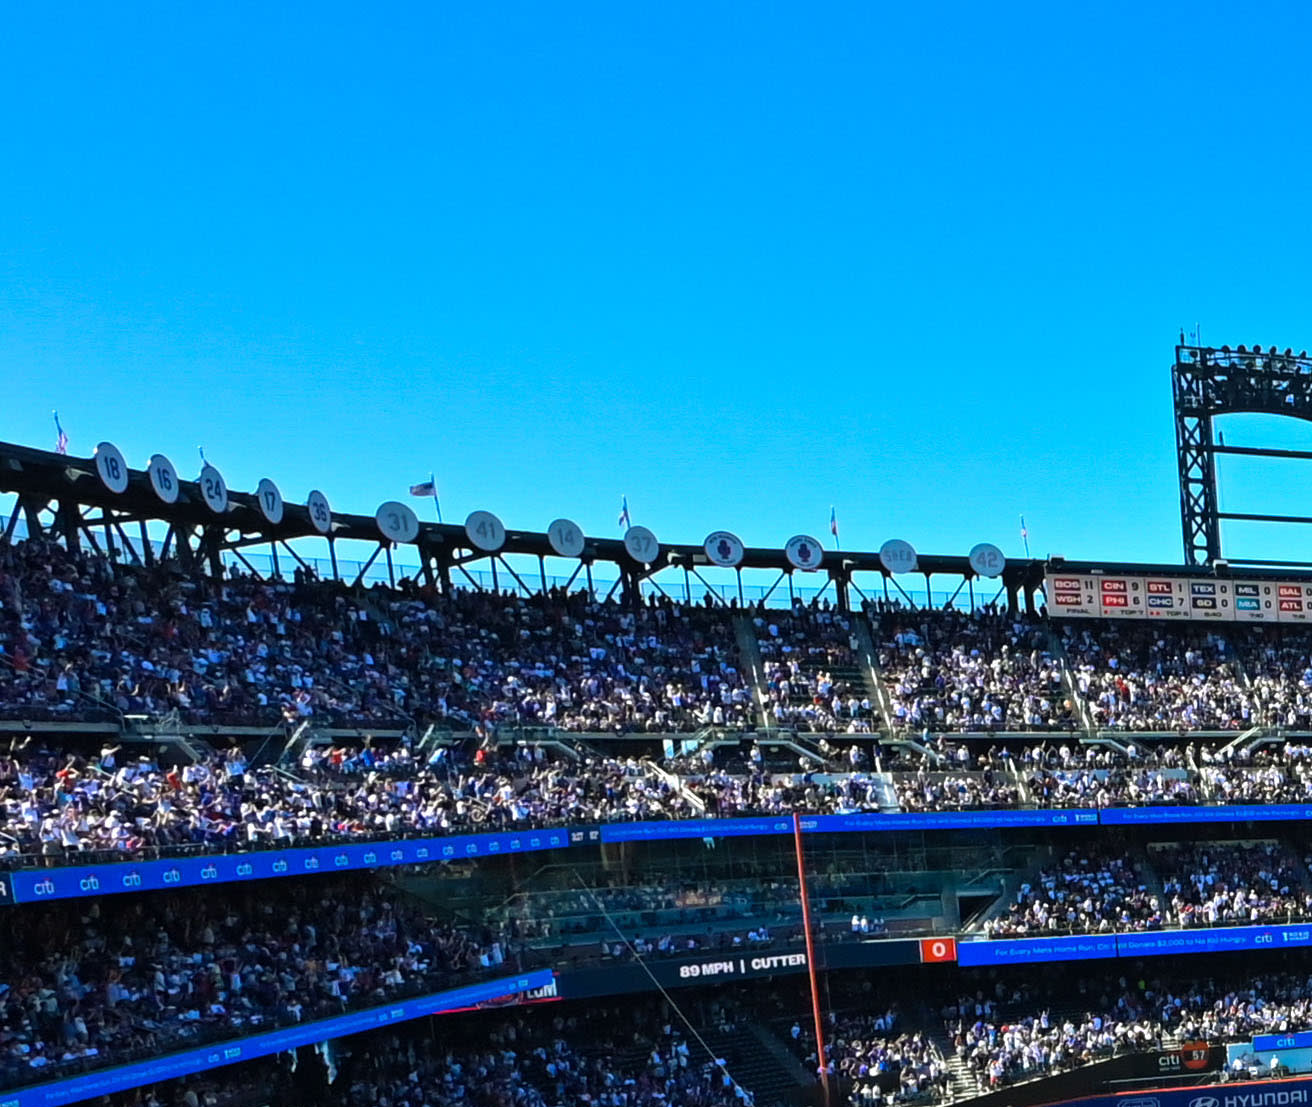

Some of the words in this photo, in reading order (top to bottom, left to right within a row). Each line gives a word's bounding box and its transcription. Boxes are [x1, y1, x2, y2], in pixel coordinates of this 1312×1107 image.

[104, 456, 120, 480] 18
[157, 469, 172, 491] 16
[206, 478, 222, 499] 24
[264, 492, 275, 511] 17
[313, 503, 327, 521] 36
[387, 513, 408, 532] 31
[476, 522, 496, 540] 41
[557, 529, 574, 546] 14
[632, 536, 650, 553] 37
[977, 551, 998, 568] 42
[1104, 582, 1124, 590] CIN
[1193, 585, 1213, 593] TEX
[1281, 601, 1300, 609] ATL
[680, 965, 700, 978] 89
[702, 962, 733, 976] MPH
[751, 953, 806, 970] CUTTER
